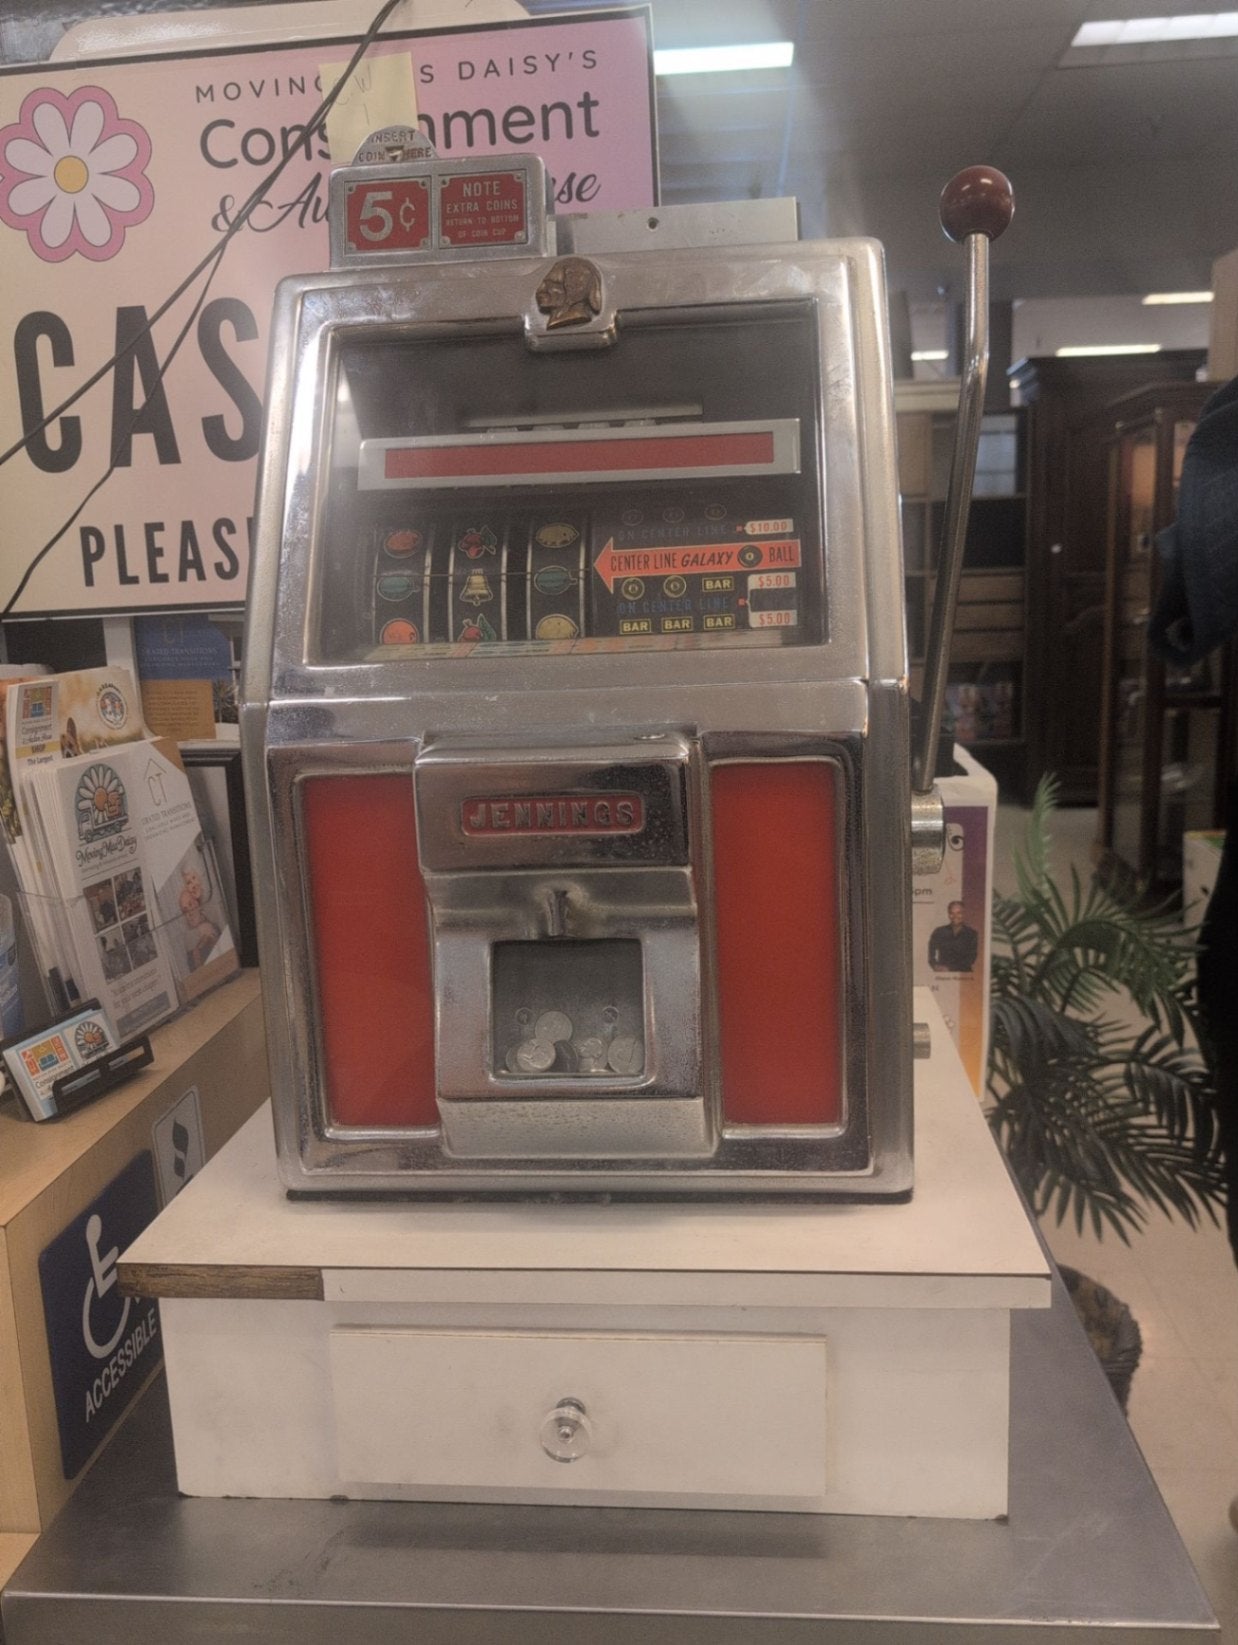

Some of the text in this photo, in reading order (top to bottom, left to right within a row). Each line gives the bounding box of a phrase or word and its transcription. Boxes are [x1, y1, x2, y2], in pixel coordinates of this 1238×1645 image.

[458, 49, 597, 81] DAISY'S
[371, 129, 416, 144] INSERT
[358, 146, 432, 163] COIN HERE
[462, 180, 501, 197] NOTE
[446, 198, 519, 215] EXTRA COINS
[14, 297, 264, 474] CAS
[750, 520, 788, 534] $10.00
[610, 545, 795, 573] CENTER LINE GALAXY BALL
[705, 579, 732, 590] BAR
[758, 574, 791, 587] $5.00
[623, 616, 733, 633] BAR BAR BAR
[758, 612, 791, 626] $5.00
[469, 801, 634, 829] JENNINGS
[912, 887, 932, 897] pm
[85, 1307, 157, 1423] ACCESSIBLE
